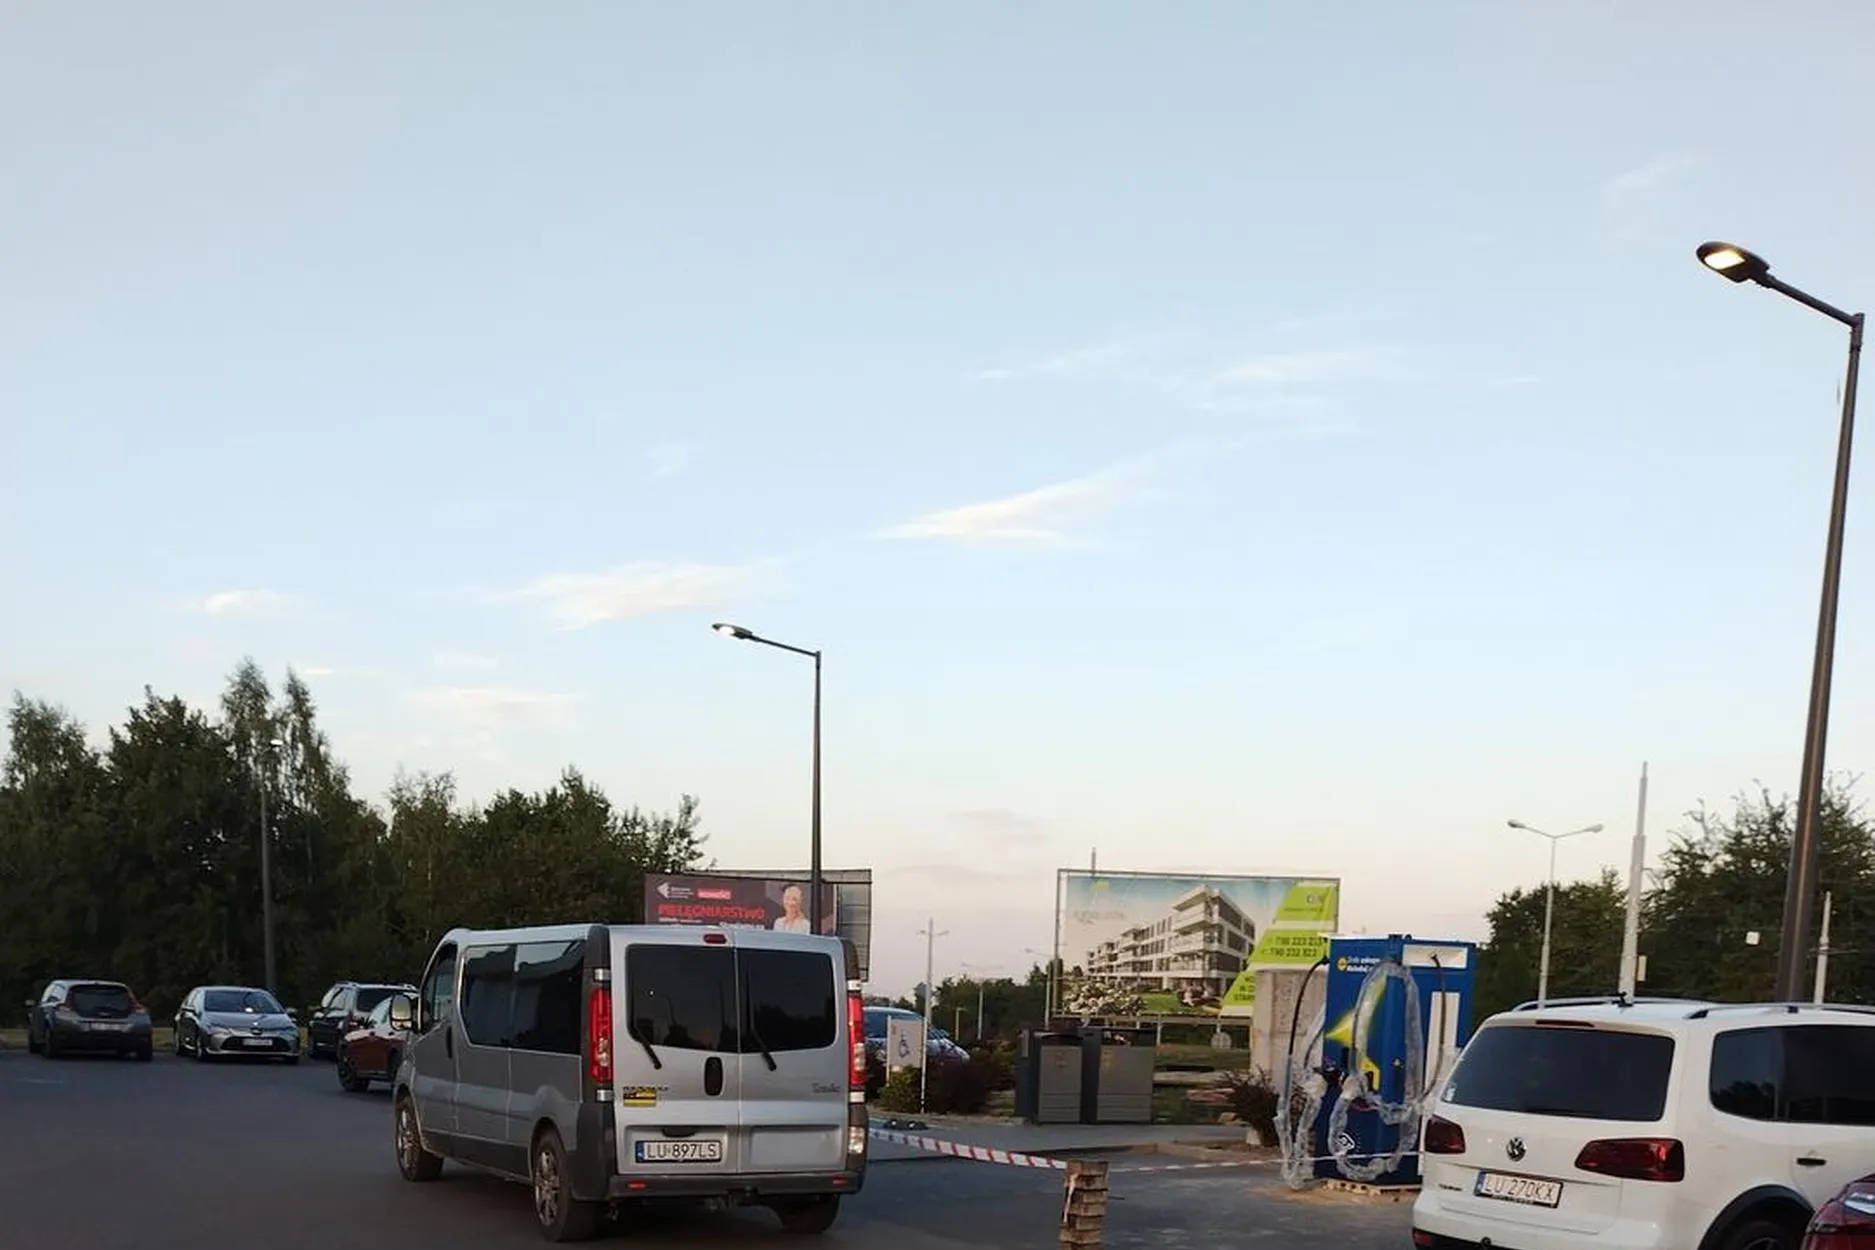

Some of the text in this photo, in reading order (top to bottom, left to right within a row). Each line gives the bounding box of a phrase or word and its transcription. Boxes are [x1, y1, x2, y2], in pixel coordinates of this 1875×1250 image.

[648, 1143, 717, 1158] LU 897LS
[1485, 1175, 1505, 1193] LU
[1507, 1178, 1554, 1201] 270KX
